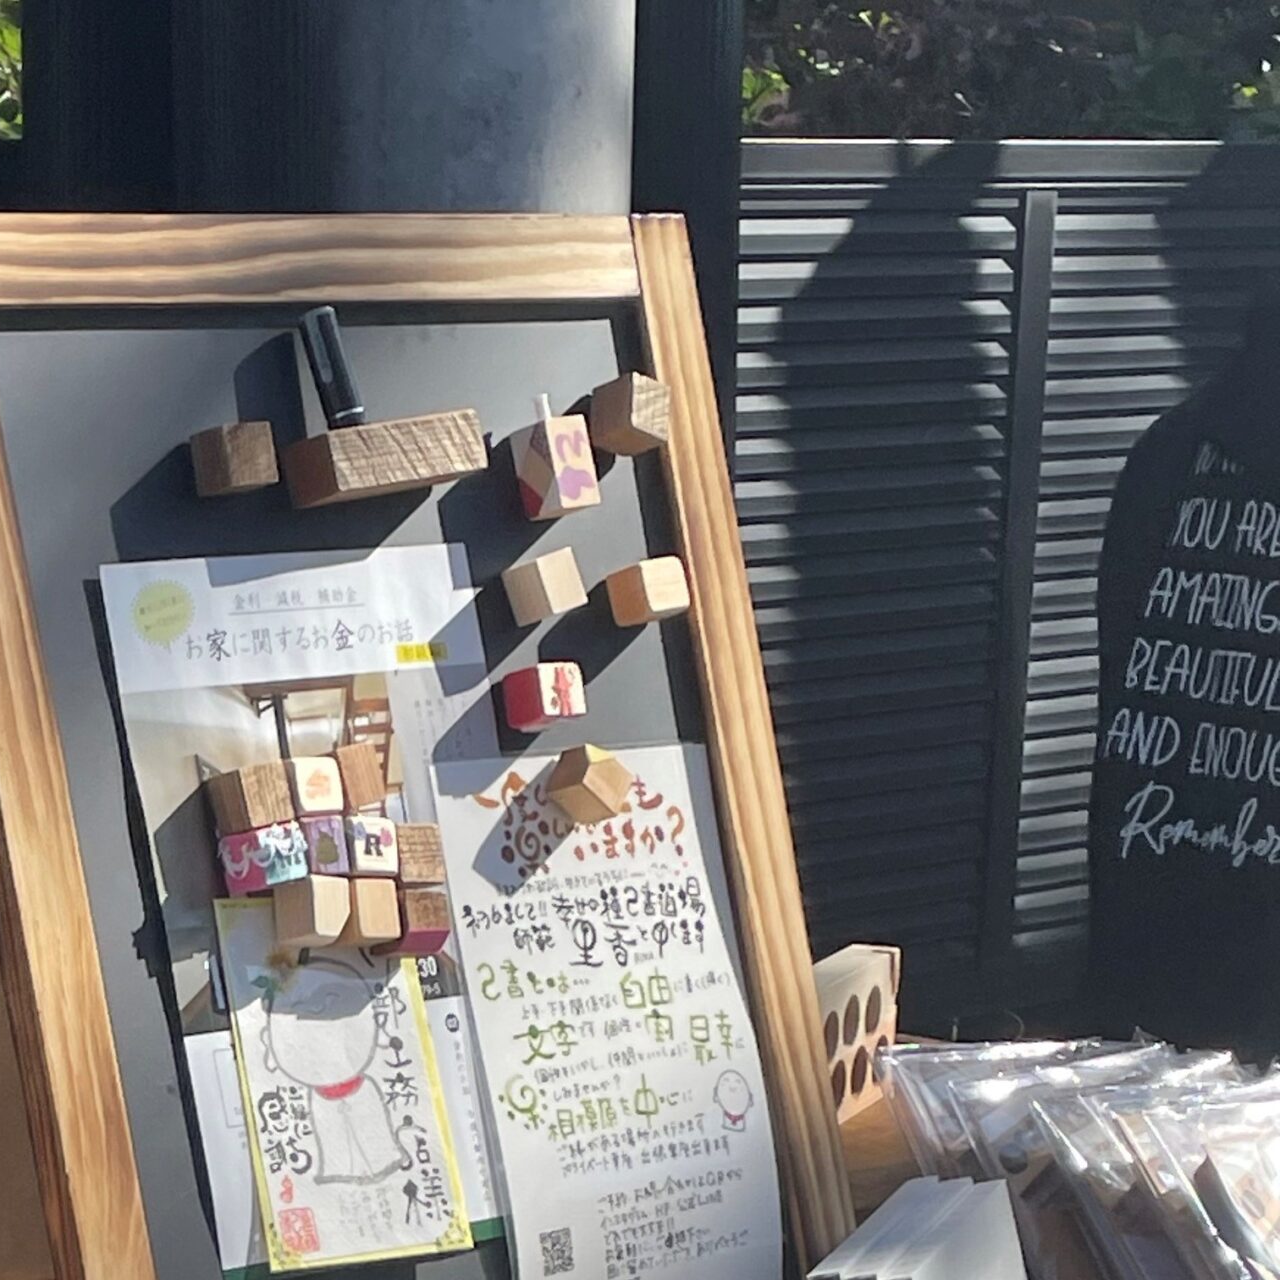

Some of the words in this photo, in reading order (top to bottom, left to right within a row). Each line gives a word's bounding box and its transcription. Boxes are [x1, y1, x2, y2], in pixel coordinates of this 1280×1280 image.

[1170, 497, 1231, 550] YOU
[185, 619, 414, 662] お家に関するお金のお話
[1104, 707, 1181, 767] AND
